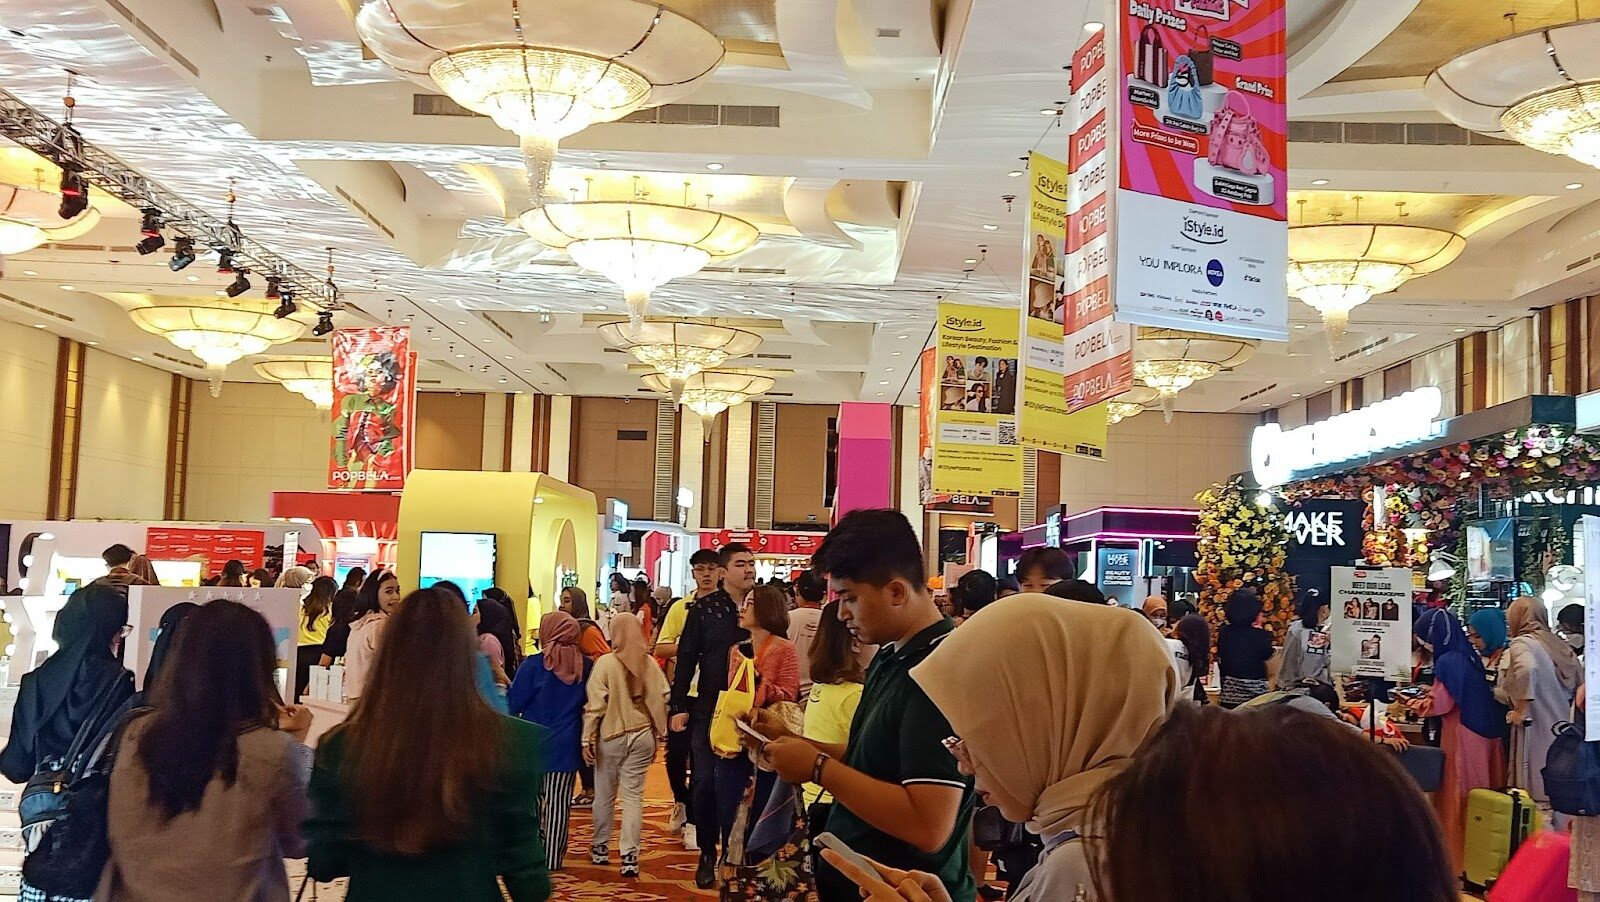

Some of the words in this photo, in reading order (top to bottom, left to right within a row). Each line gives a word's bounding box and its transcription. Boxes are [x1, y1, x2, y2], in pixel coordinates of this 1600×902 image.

[1129, 0, 1154, 24] Daily
[1155, 7, 1186, 31] Prizes
[1236, 76, 1257, 93] Grand
[1257, 82, 1273, 98] Prize
[1133, 128, 1150, 138] More
[1182, 216, 1224, 237] iStyle.id
[1139, 256, 1160, 268] YOU
[1163, 260, 1203, 275] IMPLORA
[945, 315, 982, 327] iStyle.id
[942, 342, 966, 350] Lifestyle
[967, 343, 1001, 351] Destination
[1296, 525, 1346, 546] VER
[1338, 589, 1406, 597] CHANGEMAKERS
